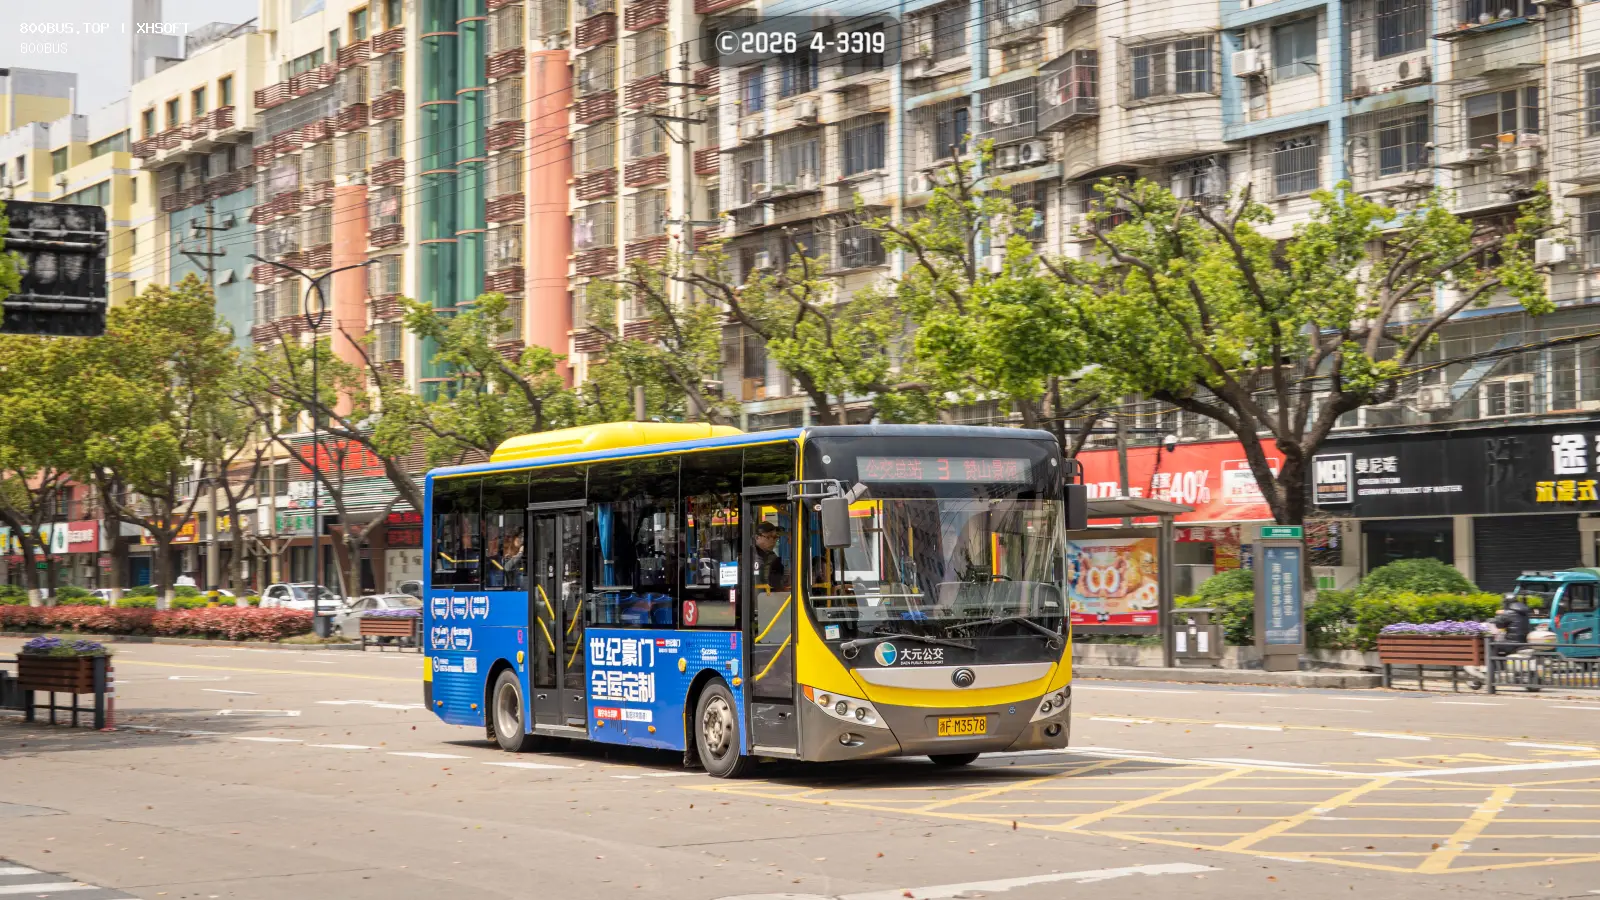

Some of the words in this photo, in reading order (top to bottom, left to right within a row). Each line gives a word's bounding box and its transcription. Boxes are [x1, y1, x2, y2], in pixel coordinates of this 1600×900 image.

[865, 459, 923, 480] 公交总站
[936, 459, 950, 480] 3
[1170, 470, 1211, 504] 40%
[1536, 480, 1598, 502] 沉浸式
[685, 602, 695, 622] 3
[590, 637, 655, 668] 世纪豪门
[900, 648, 944, 661] 大元公交
[591, 670, 656, 703] 全屋定制
